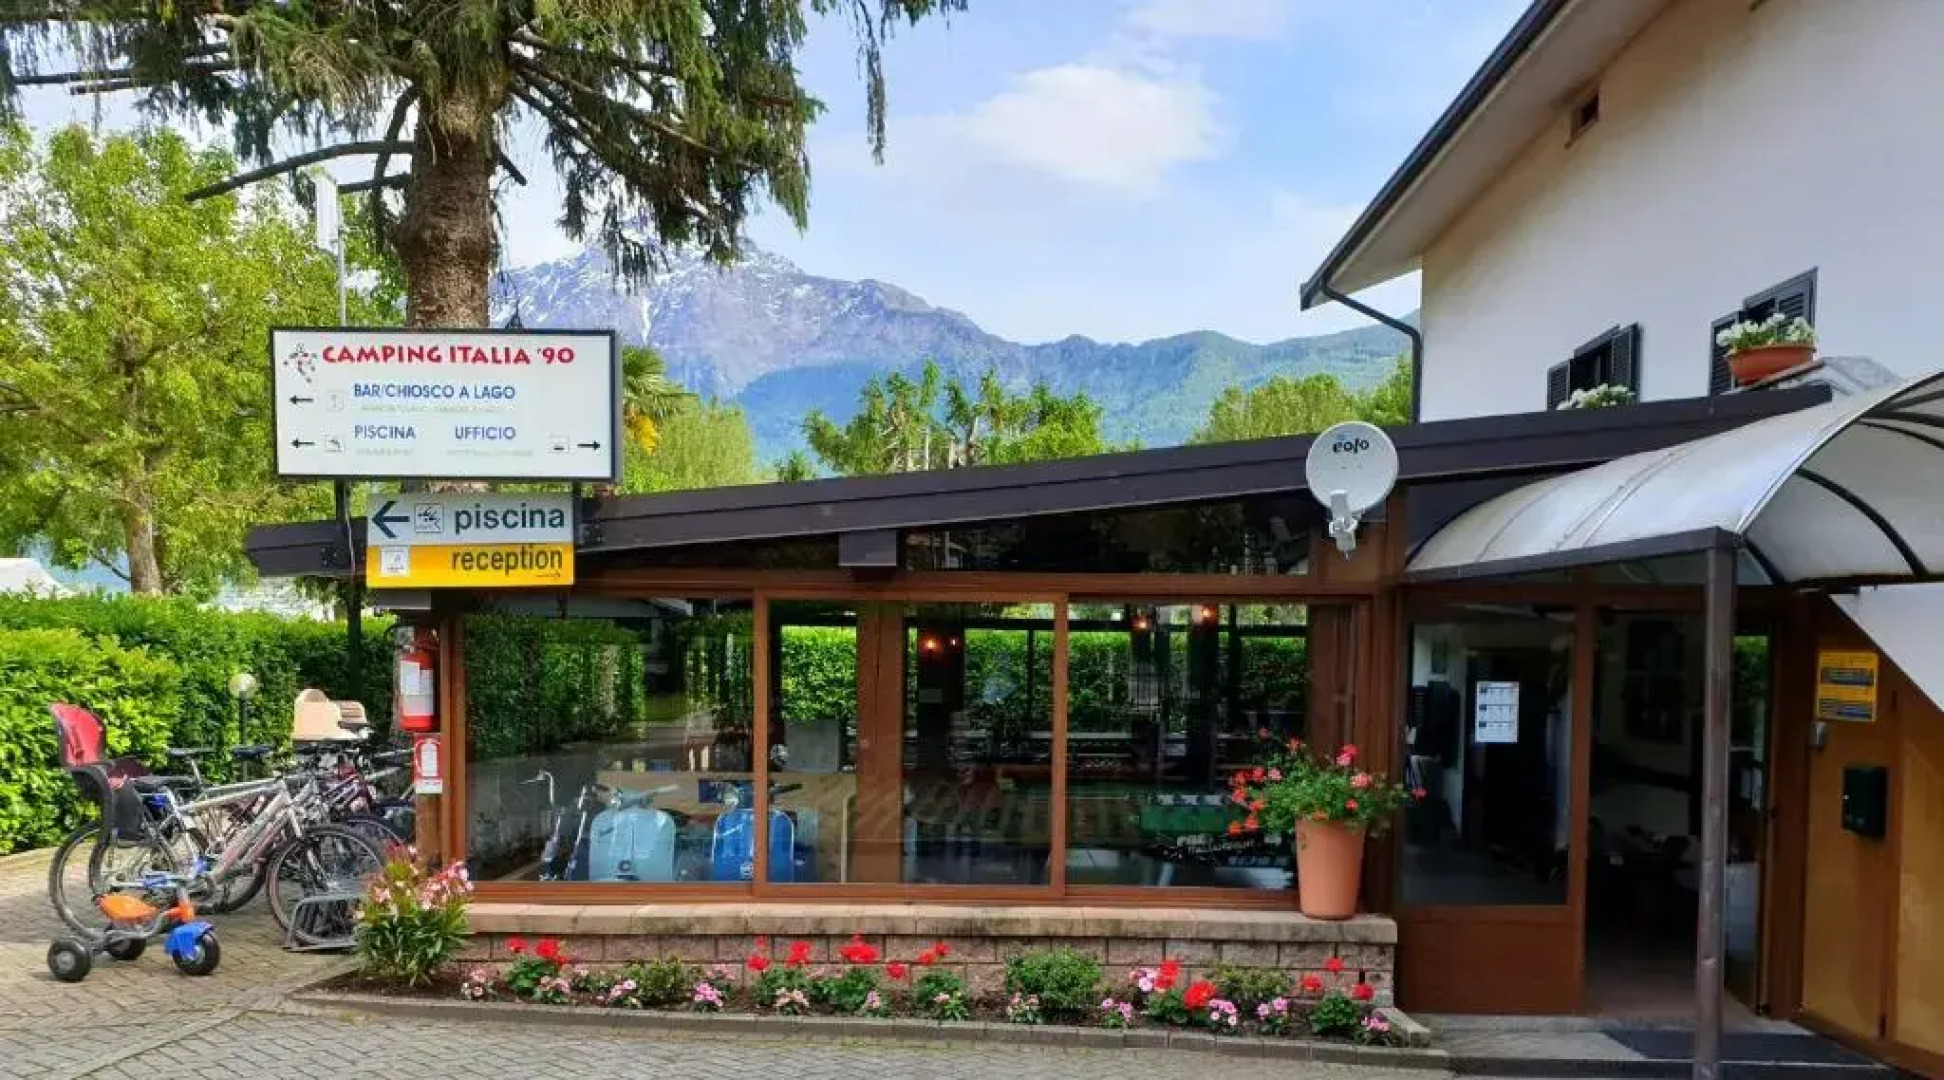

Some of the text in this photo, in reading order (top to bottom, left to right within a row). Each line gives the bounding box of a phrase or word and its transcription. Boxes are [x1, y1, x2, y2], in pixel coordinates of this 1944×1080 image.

[322, 345, 576, 365] CAMPING ITALIA '90
[354, 383, 516, 399] BAR/CHIOSCO A LAGO
[354, 425, 416, 439] PISCINA
[455, 426, 517, 440] UFFICIO
[454, 502, 565, 535] piscina
[452, 544, 563, 576] reception
